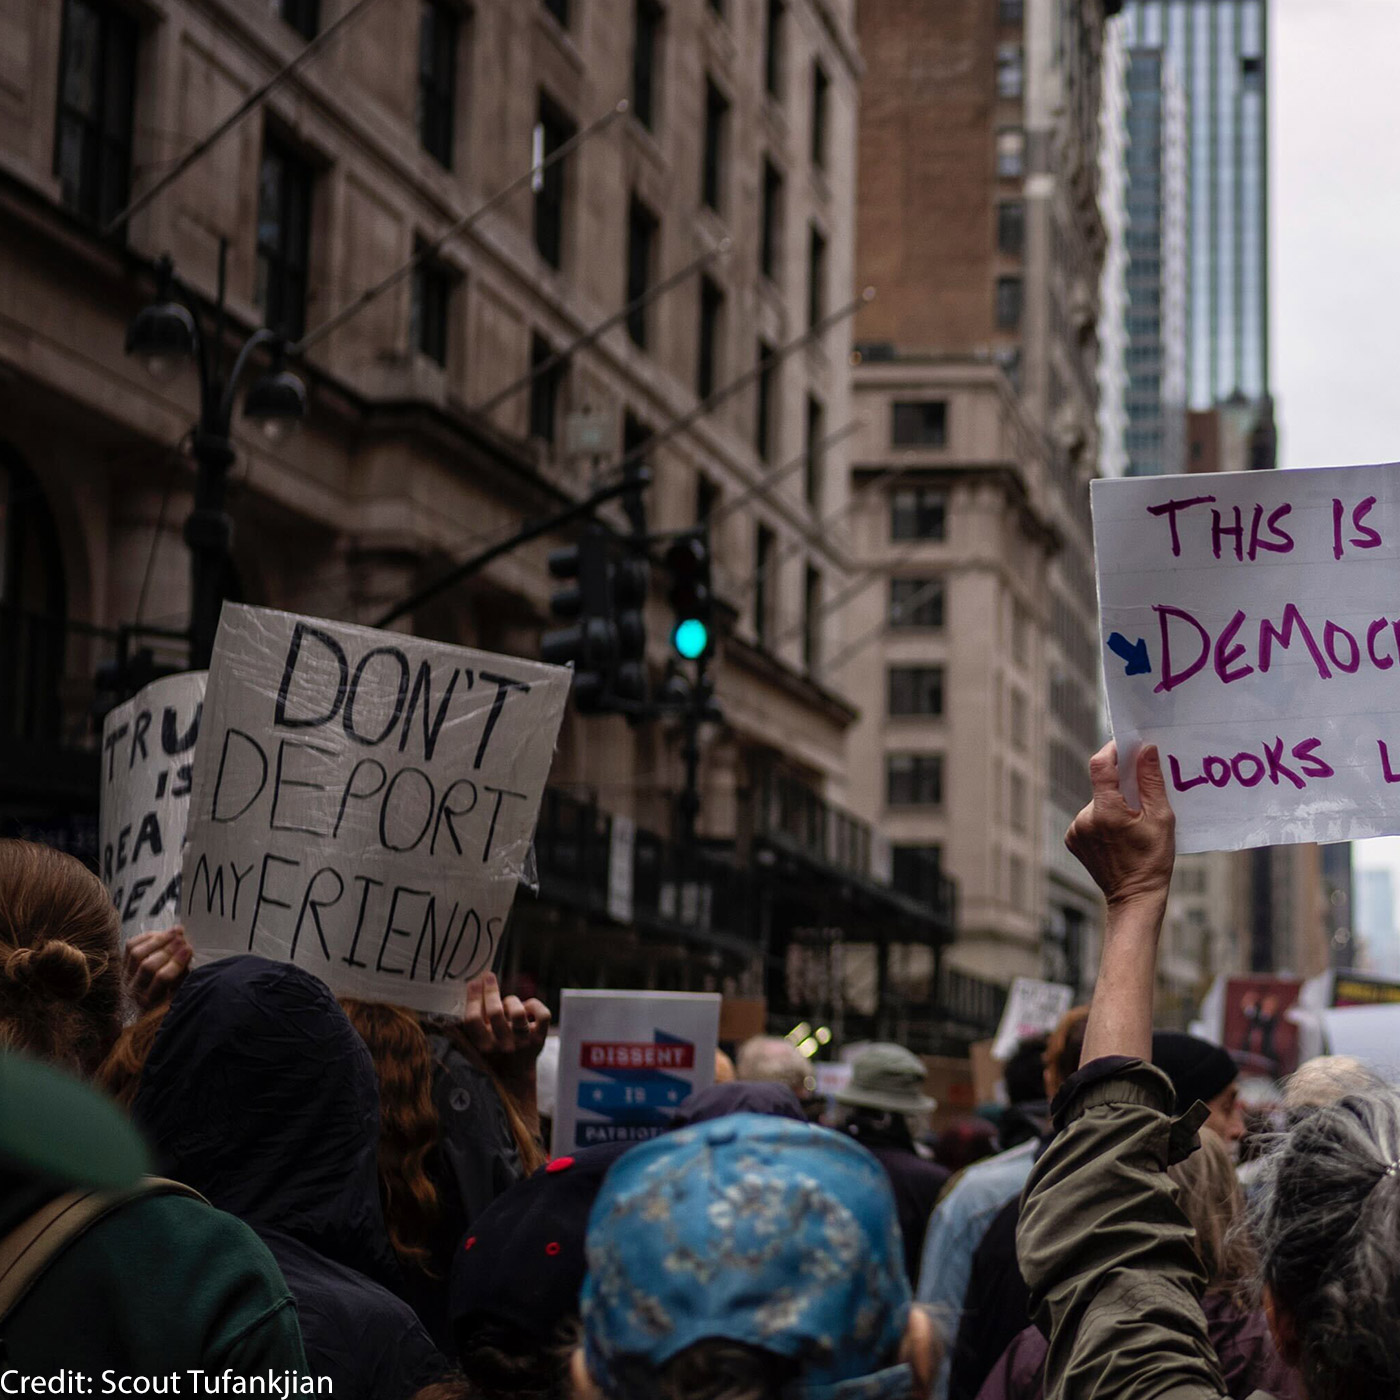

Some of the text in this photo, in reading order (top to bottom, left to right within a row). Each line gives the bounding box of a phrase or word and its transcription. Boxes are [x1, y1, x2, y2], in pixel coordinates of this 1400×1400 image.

[1147, 496, 1294, 561] THIS
[1332, 496, 1382, 560] IS
[274, 622, 531, 769] DON'T
[1167, 736, 1335, 792] LOOKS
[212, 728, 527, 863] DEPORT
[104, 811, 188, 883] REA
[591, 1046, 683, 1066] DISSENT
[625, 1086, 646, 1104] IS
[586, 1126, 662, 1141] PATRIOT
